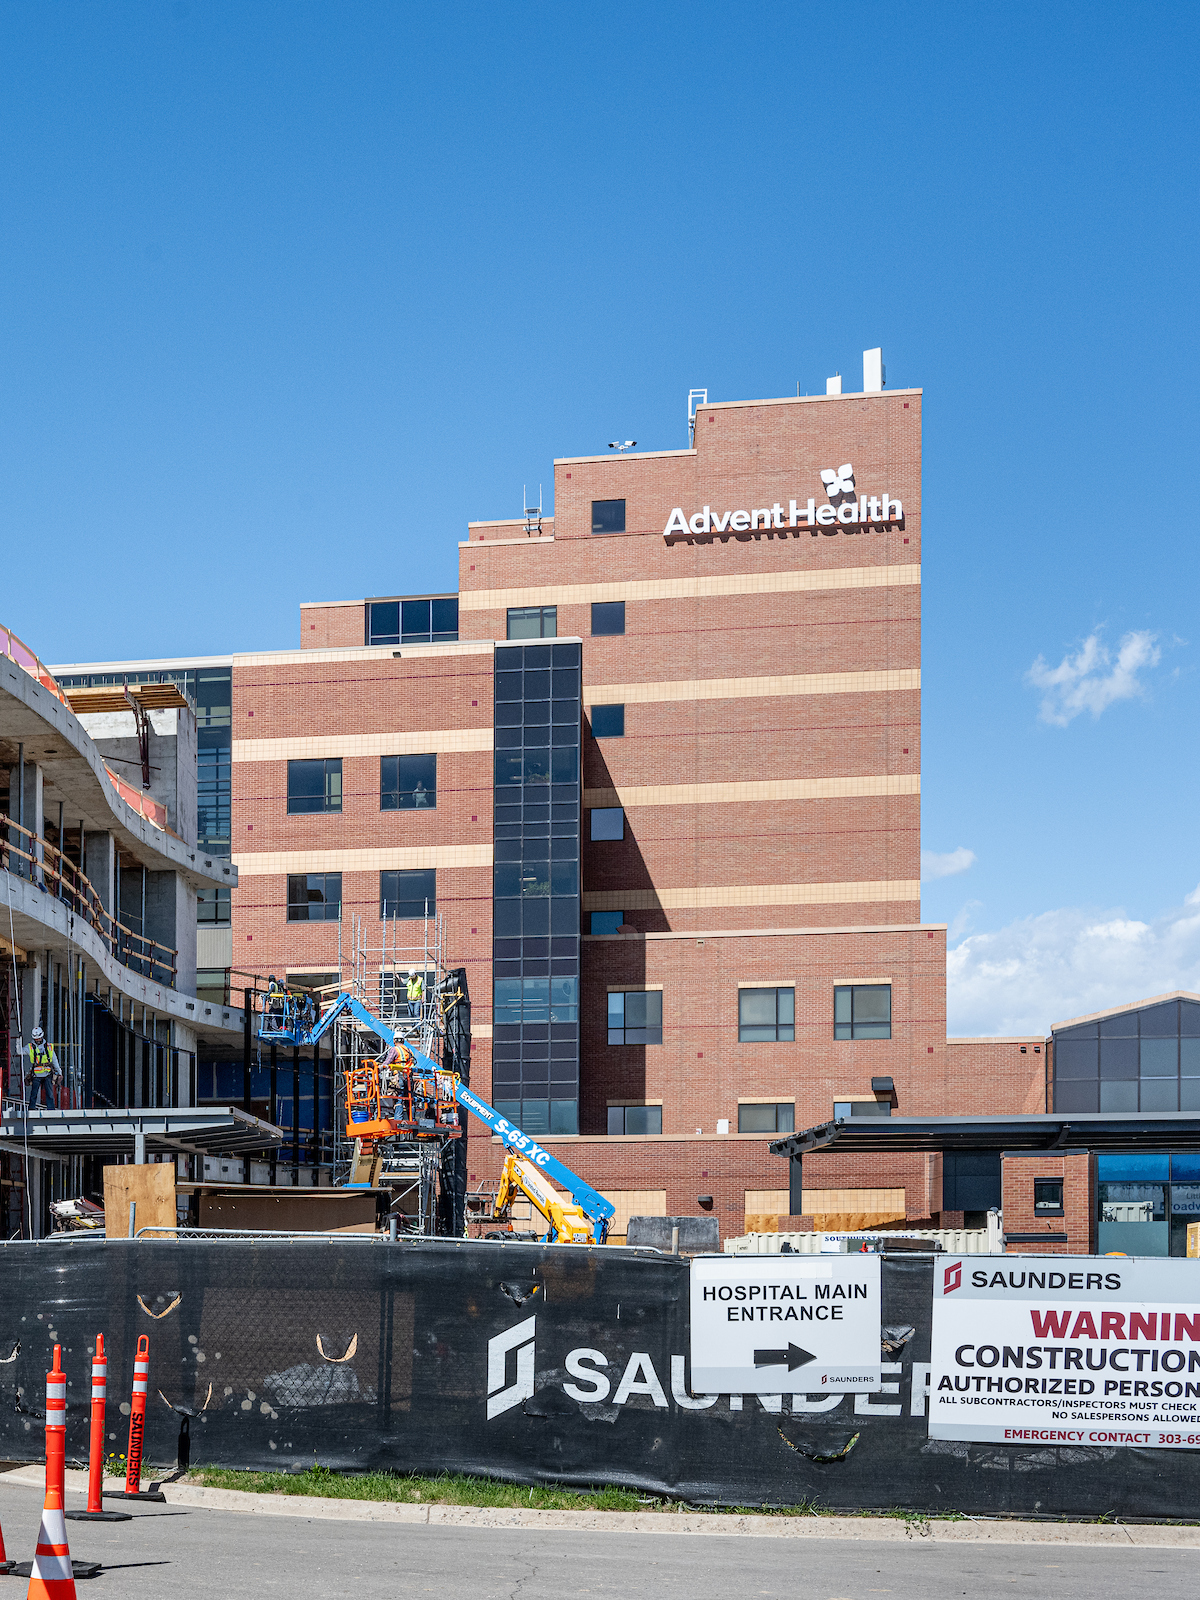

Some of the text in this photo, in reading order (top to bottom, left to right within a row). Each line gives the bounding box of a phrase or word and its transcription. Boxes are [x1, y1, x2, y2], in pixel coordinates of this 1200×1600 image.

[663, 493, 903, 536] AdventHealth
[460, 1091, 494, 1120] EQUIPMENT
[494, 1119, 550, 1165] S-65 XC
[971, 1270, 1122, 1290] SAUNDERS
[703, 1284, 868, 1301] HOSPITAL MAIN
[727, 1305, 844, 1322] ENTRANCE
[1030, 1310, 1200, 1341] WARNIN
[829, 1375, 875, 1383] SAUNDERS
[937, 1375, 1200, 1398] AUTHORIZED PERSON
[939, 1396, 1197, 1411] ALL SUBCONTRACTORS/INSPECTORS MUST CHECK
[1052, 1411, 1068, 1420] NO
[1071, 1412, 1150, 1422] SALESPERSONS
[1004, 1429, 1085, 1442] EMERGENCY
[1088, 1432, 1151, 1444] CONTACT
[128, 1411, 143, 1487] SAUNDERS
